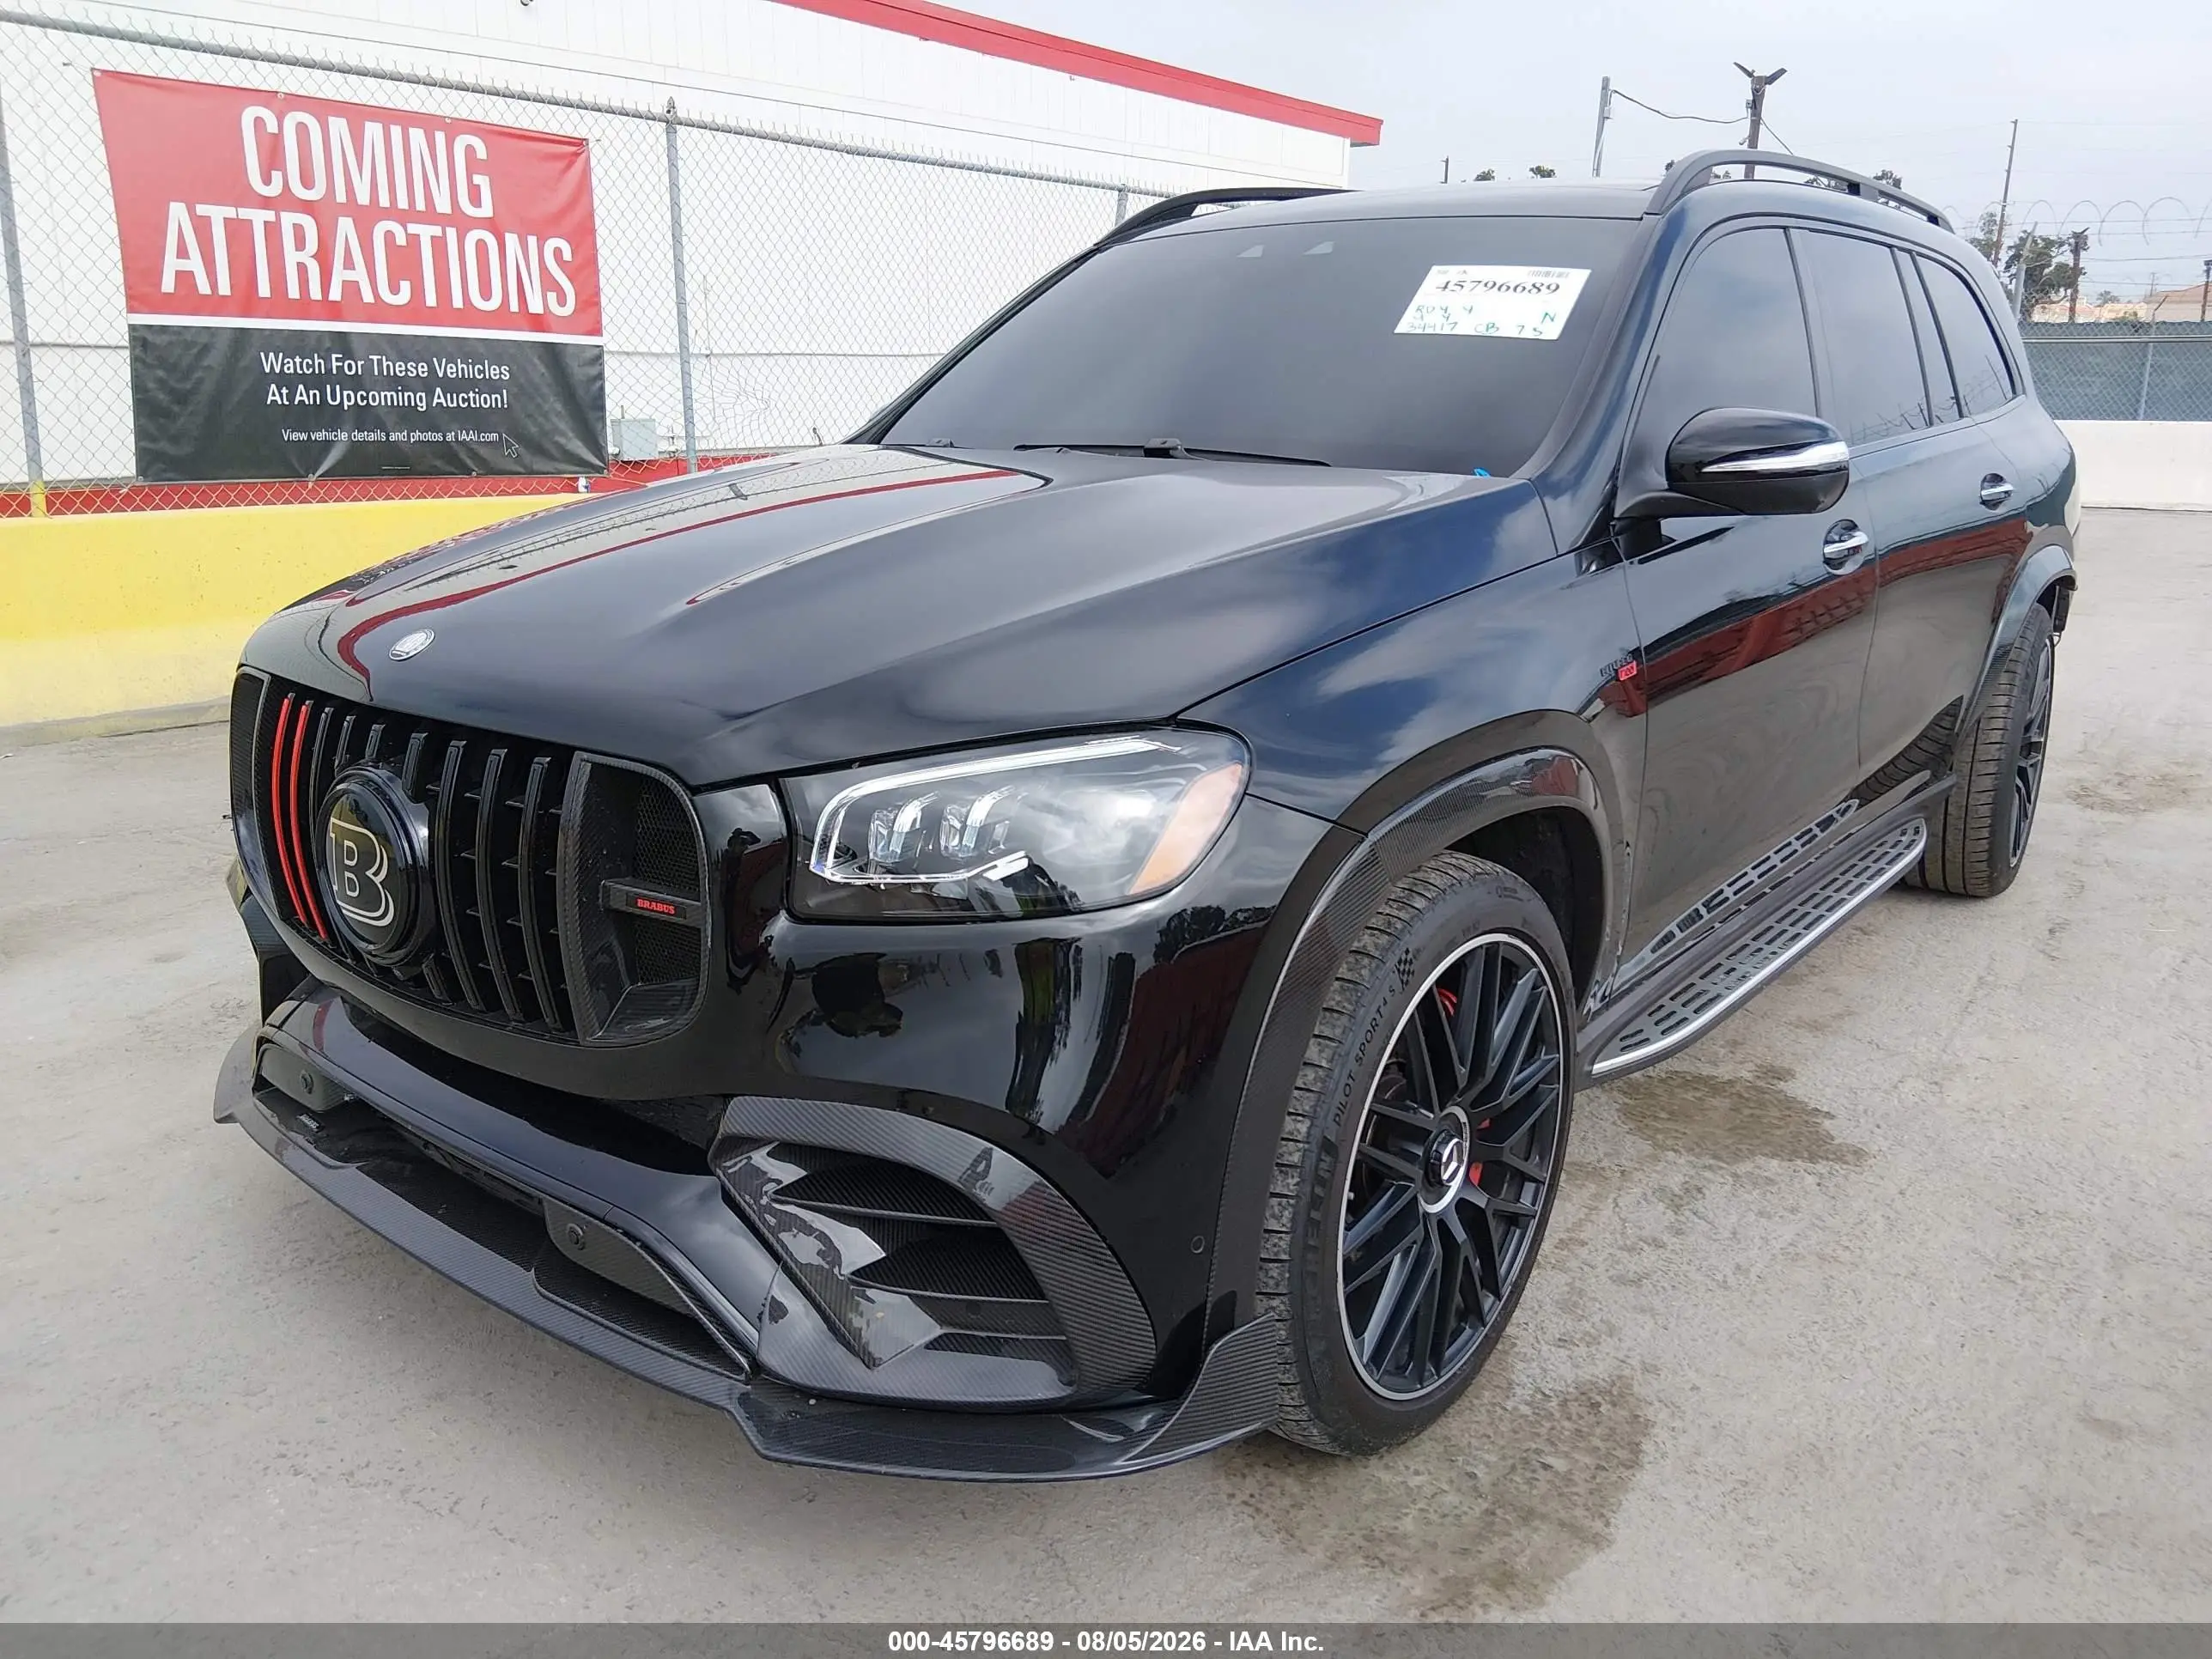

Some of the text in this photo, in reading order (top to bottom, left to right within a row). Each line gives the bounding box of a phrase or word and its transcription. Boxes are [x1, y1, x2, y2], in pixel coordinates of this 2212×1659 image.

[240, 105, 495, 218] COMING
[161, 202, 576, 317] ATTRACTIONS
[1436, 280, 1560, 294] 45796689
[260, 351, 510, 380] Watch For These Vehicles
[266, 383, 508, 411] At An Upcoming Auction!
[282, 428, 499, 443] View vehicle details and photos at IAAI.com
[637, 898, 675, 915] BRABUS
[1333, 1069, 1356, 1127] PILOT
[1354, 1006, 1383, 1066] SPORT
[1389, 984, 1395, 997] S
